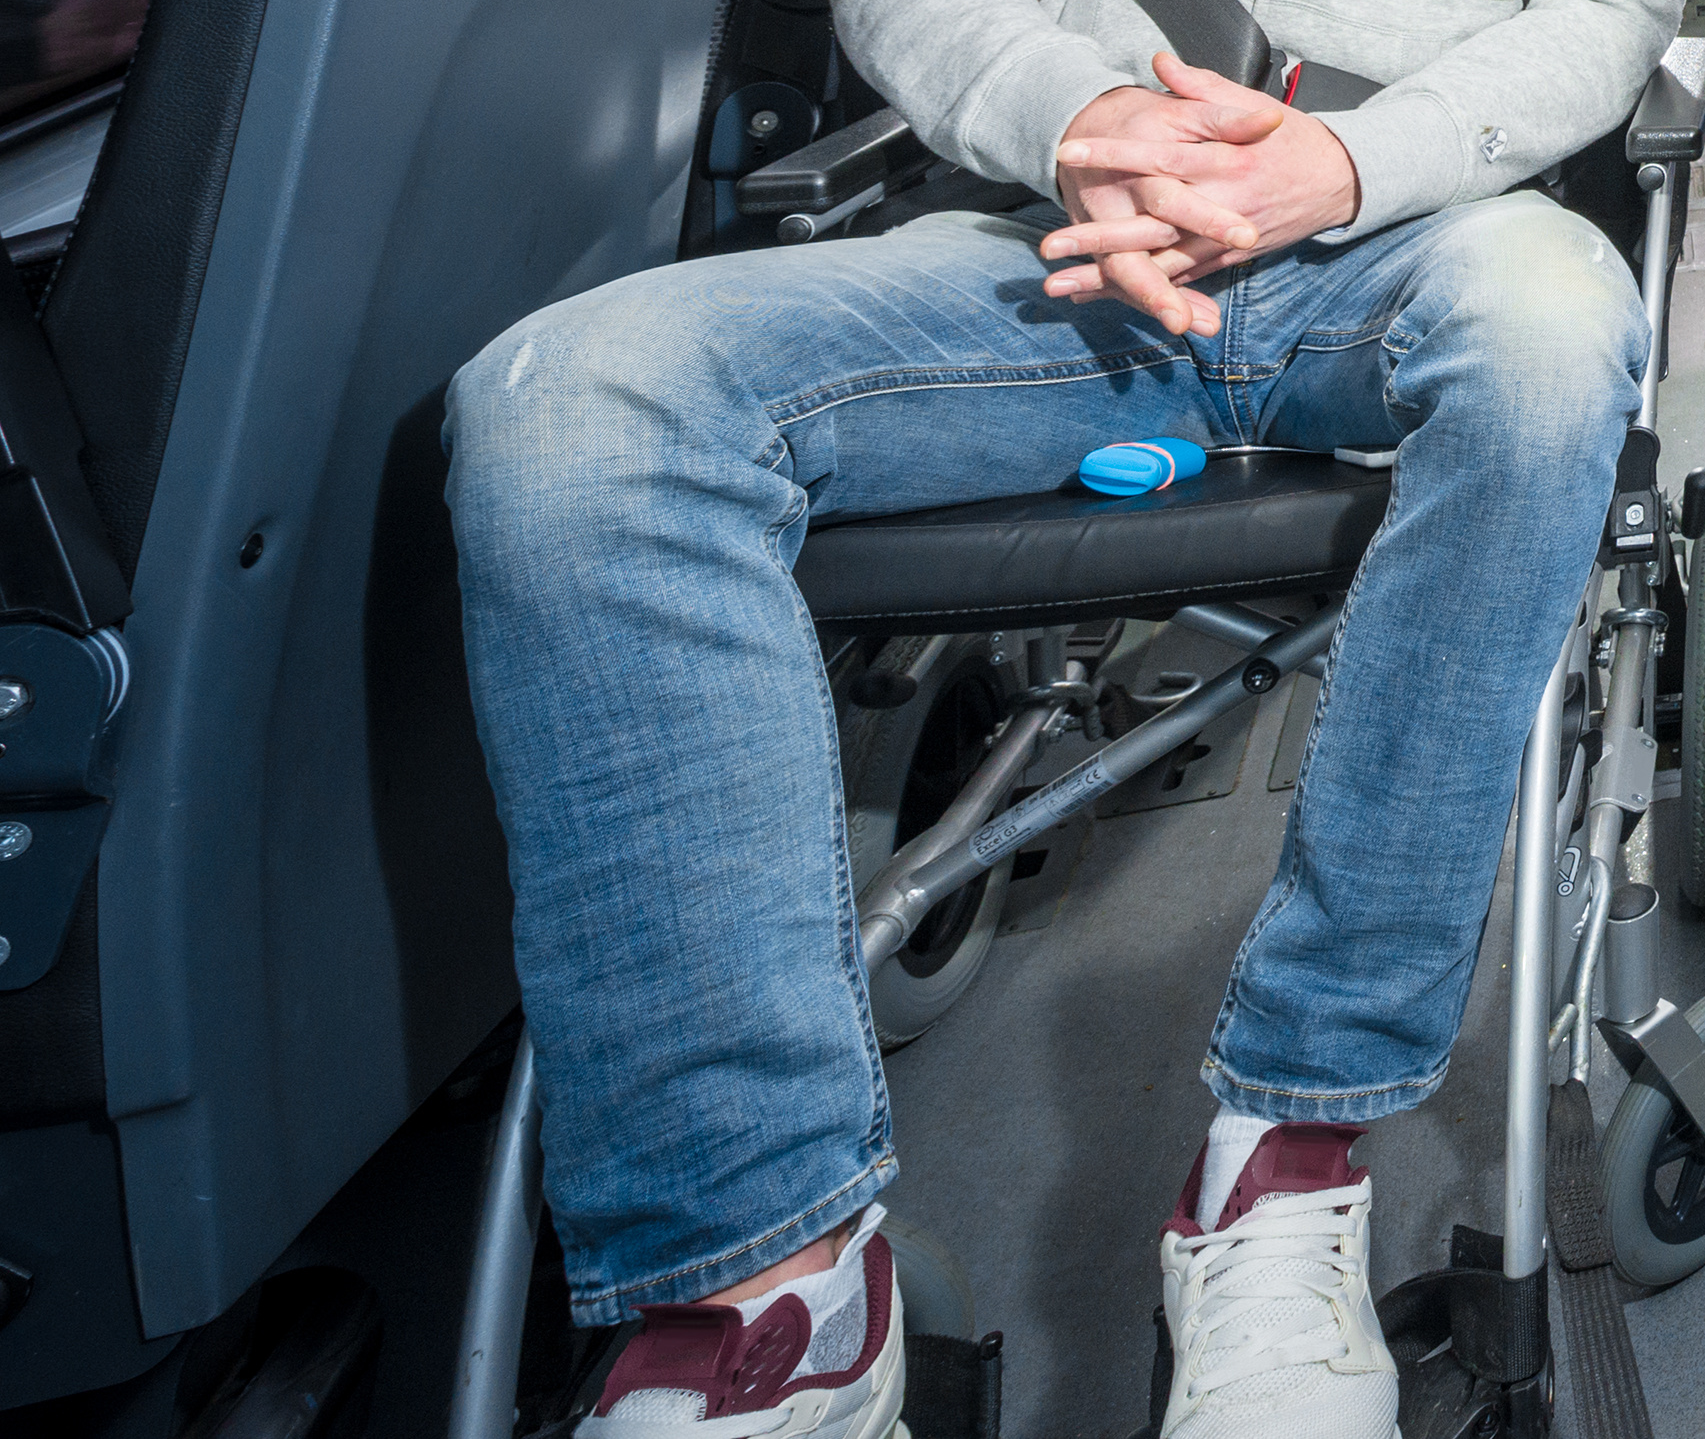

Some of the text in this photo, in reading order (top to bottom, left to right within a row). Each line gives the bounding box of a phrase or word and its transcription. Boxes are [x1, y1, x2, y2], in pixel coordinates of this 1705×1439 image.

[1085, 769, 1101, 784] CE
[976, 834, 1002, 855] Excel
[1003, 825, 1018, 838] G3
